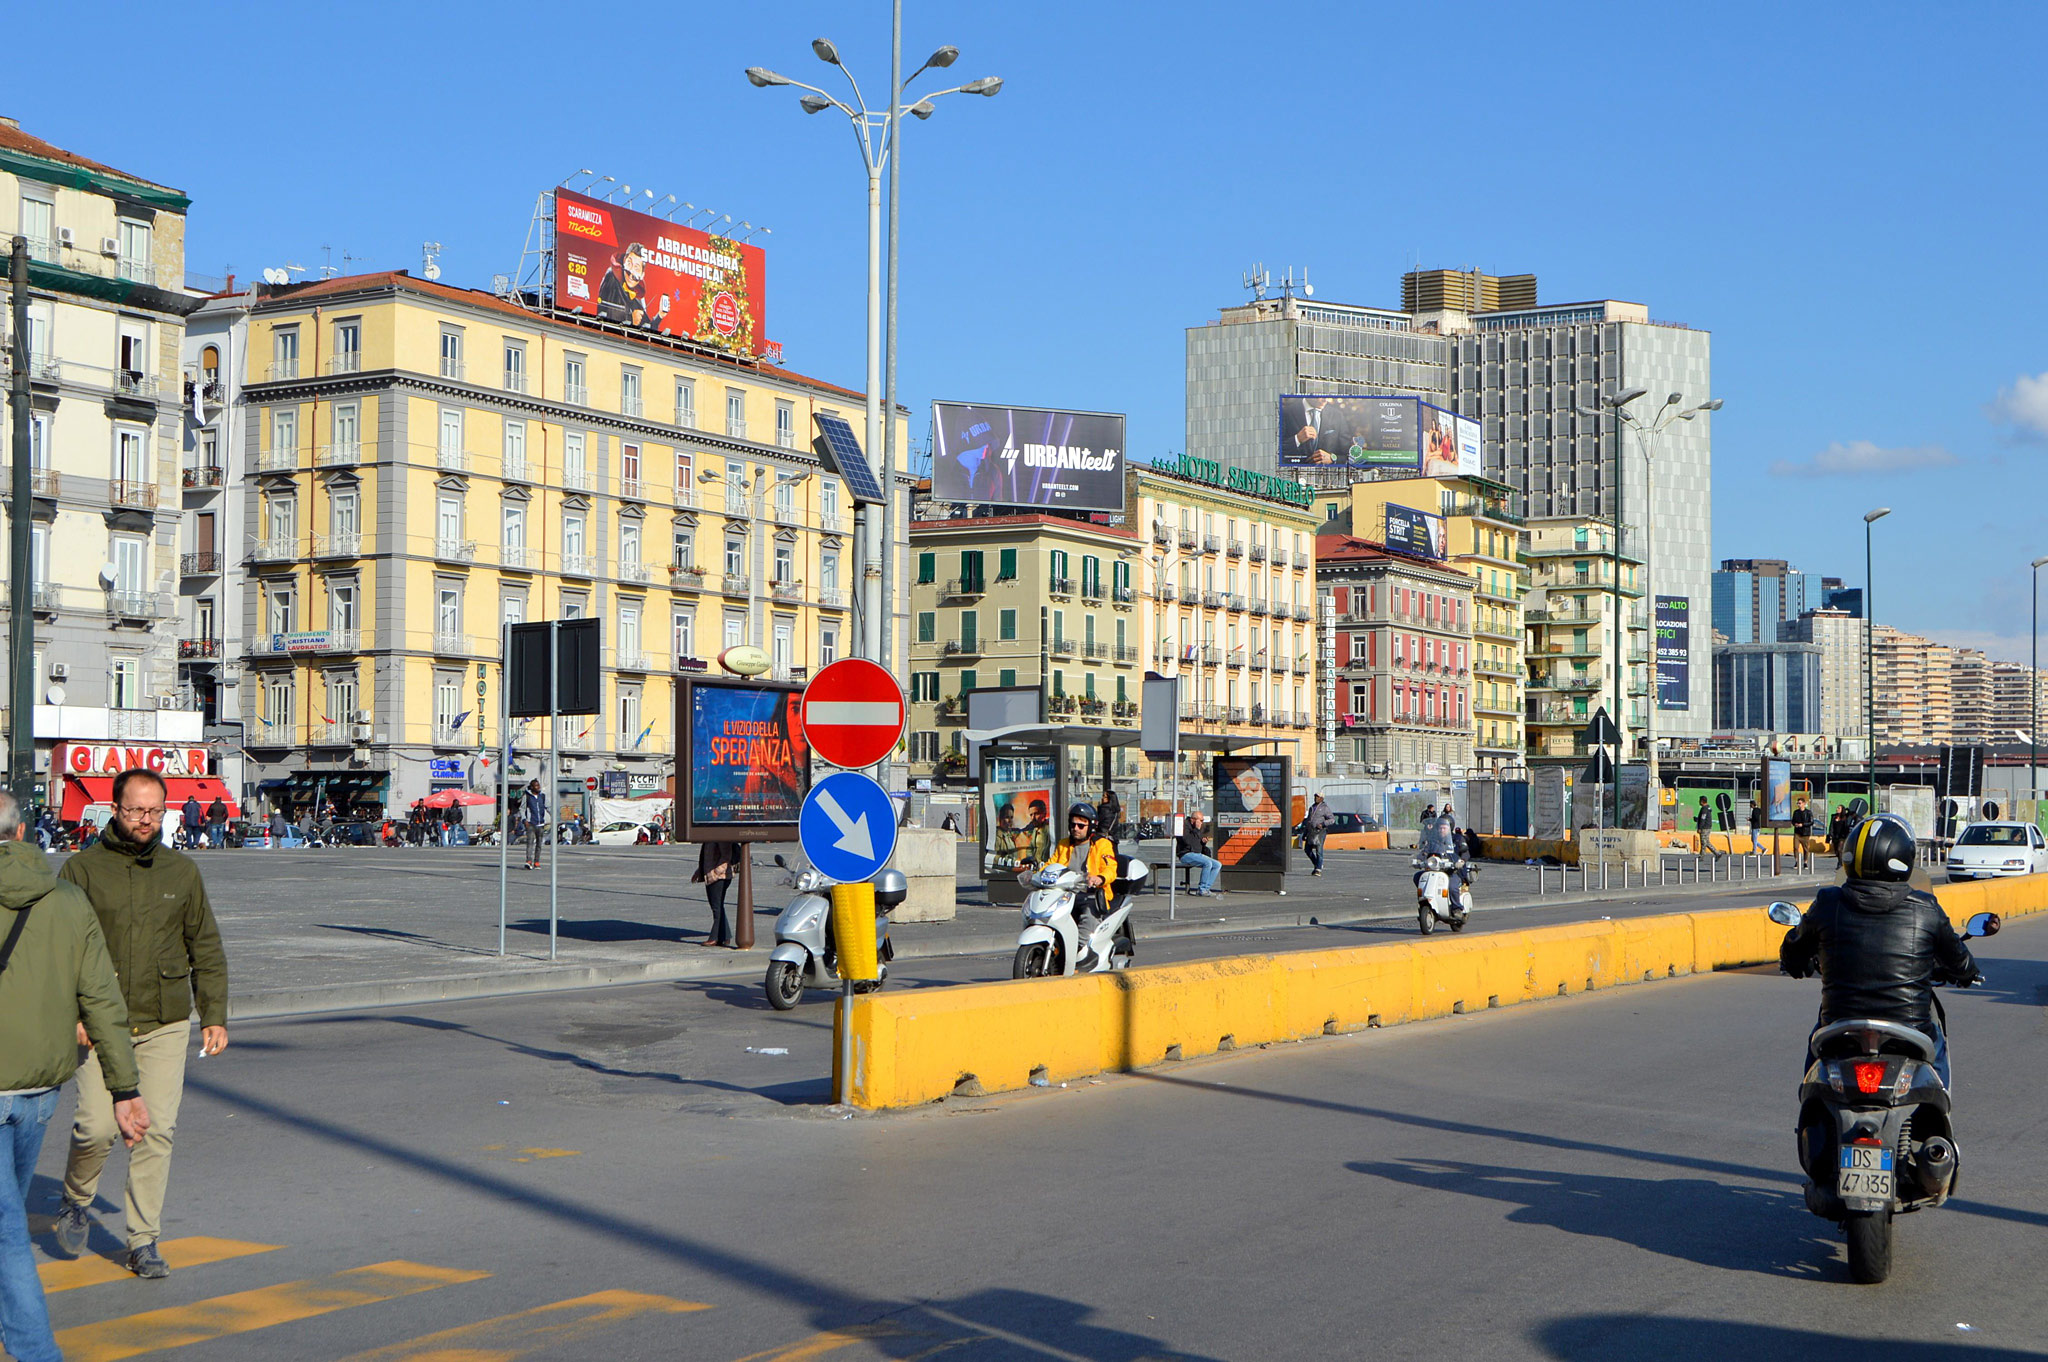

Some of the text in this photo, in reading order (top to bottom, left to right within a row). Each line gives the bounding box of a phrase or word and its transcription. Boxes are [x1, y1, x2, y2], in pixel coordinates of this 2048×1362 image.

[568, 221, 602, 237] modo
[657, 236, 739, 272] ABRACADABRA
[641, 248, 724, 284] SCARAMUSICA!
[1178, 453, 1316, 506] HOTEL SANT'ANGELO
[1669, 601, 1687, 610] ALTO
[1326, 597, 1335, 648] HOTEL
[1656, 620, 1687, 628] LOCAZIONE
[1656, 629, 1676, 639] FFICI
[1679, 649, 1687, 657] 93
[476, 664, 487, 747] HOTEL
[723, 720, 779, 737] IL VIZIO DELLA
[71, 746, 204, 774] GIANCAR
[711, 736, 792, 766] SPERANZA
[1853, 1149, 1871, 1168] DS
